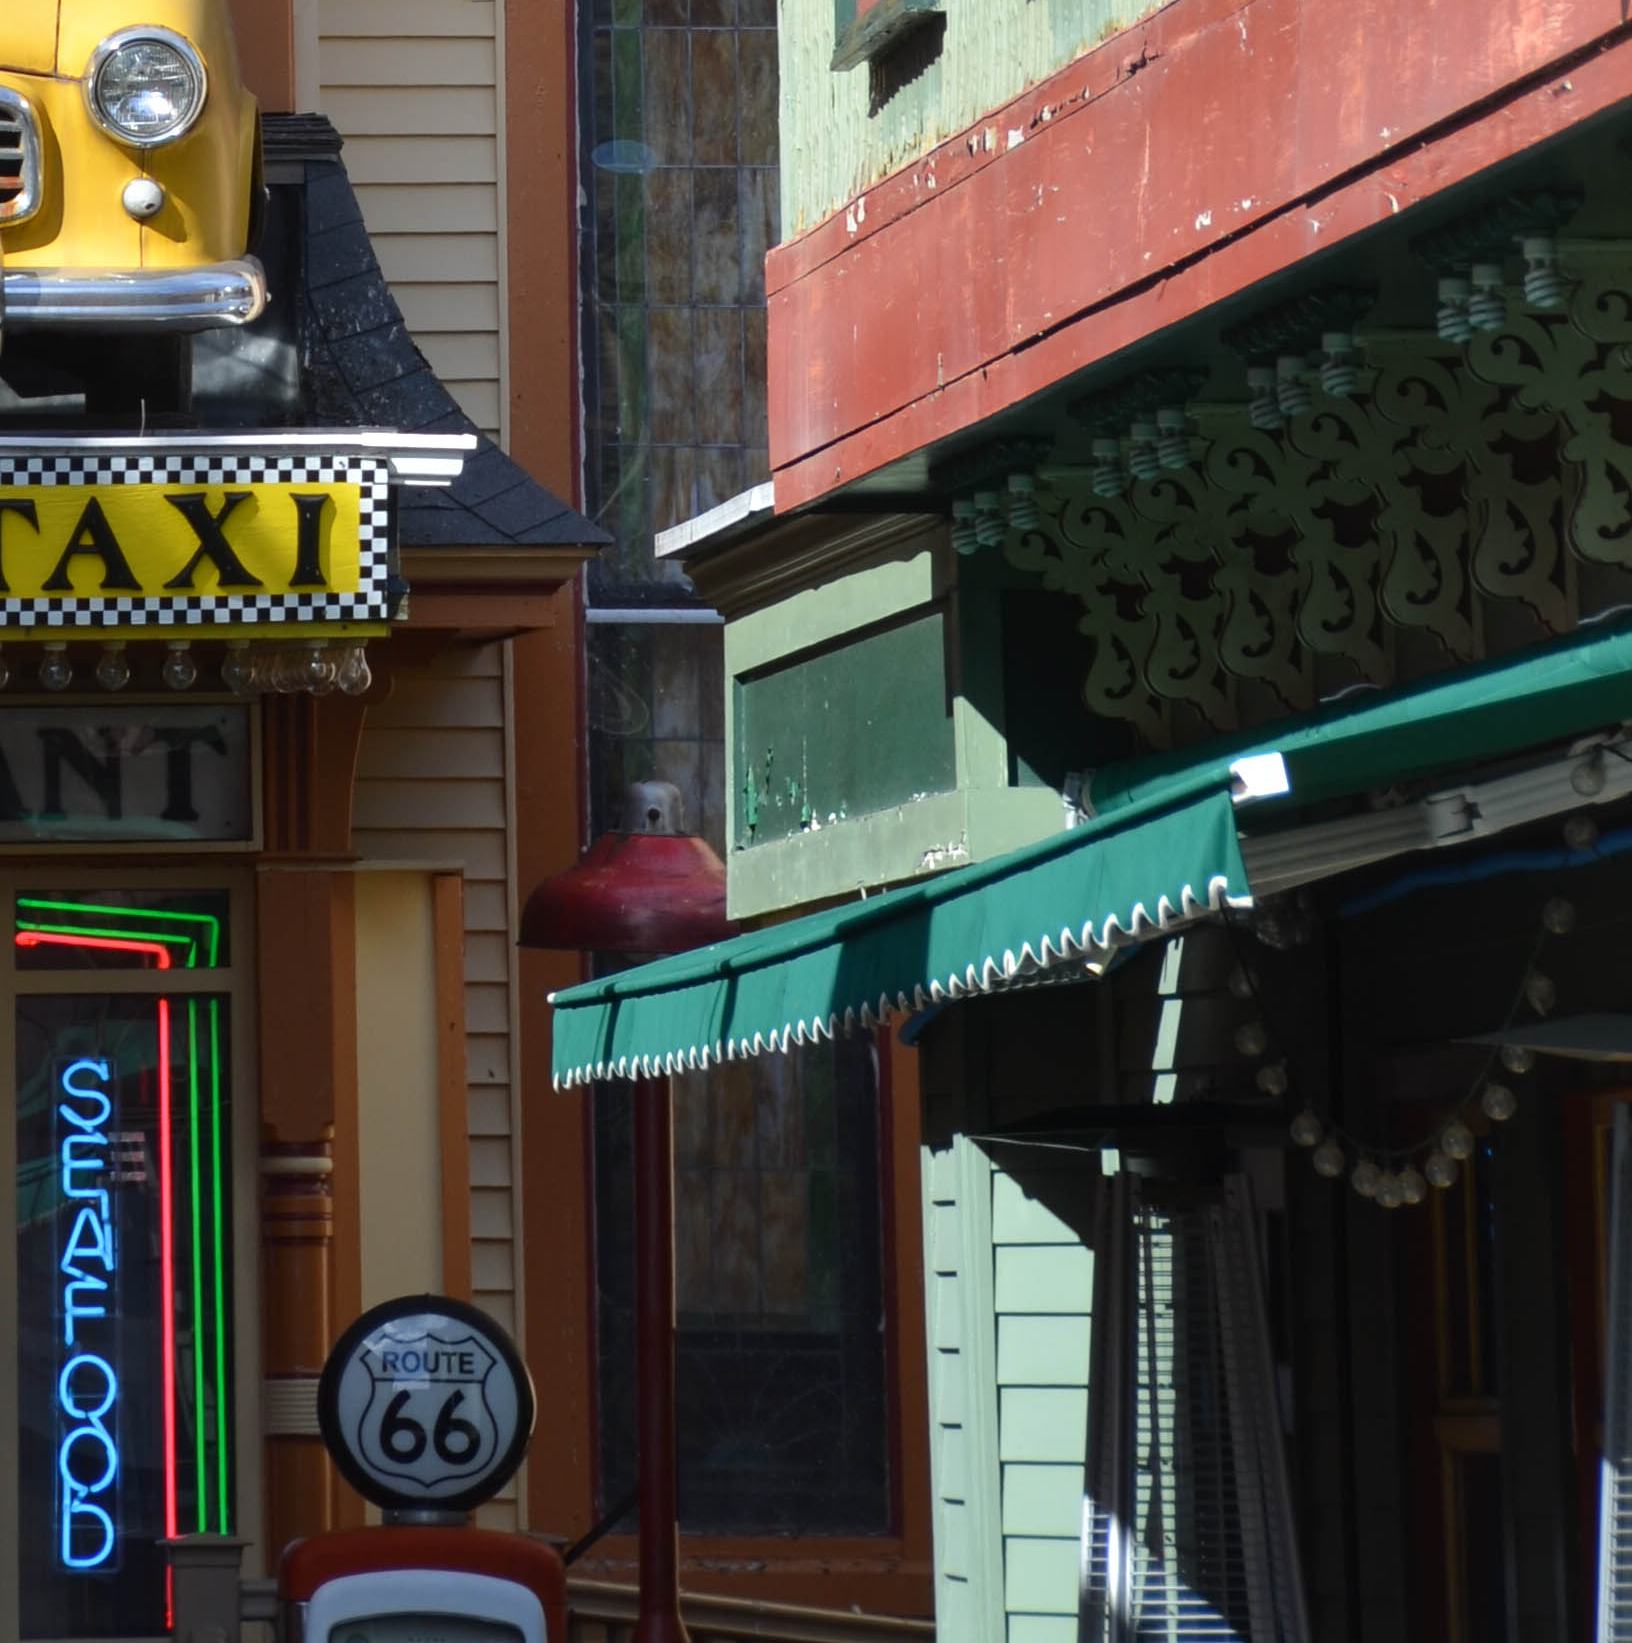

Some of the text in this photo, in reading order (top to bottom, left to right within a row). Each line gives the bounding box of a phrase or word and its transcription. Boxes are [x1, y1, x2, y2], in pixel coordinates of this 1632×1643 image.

[58, 1057, 119, 1569] SEAFOOD
[380, 1349, 476, 1375] ROUTE
[379, 1389, 481, 1466] 66
